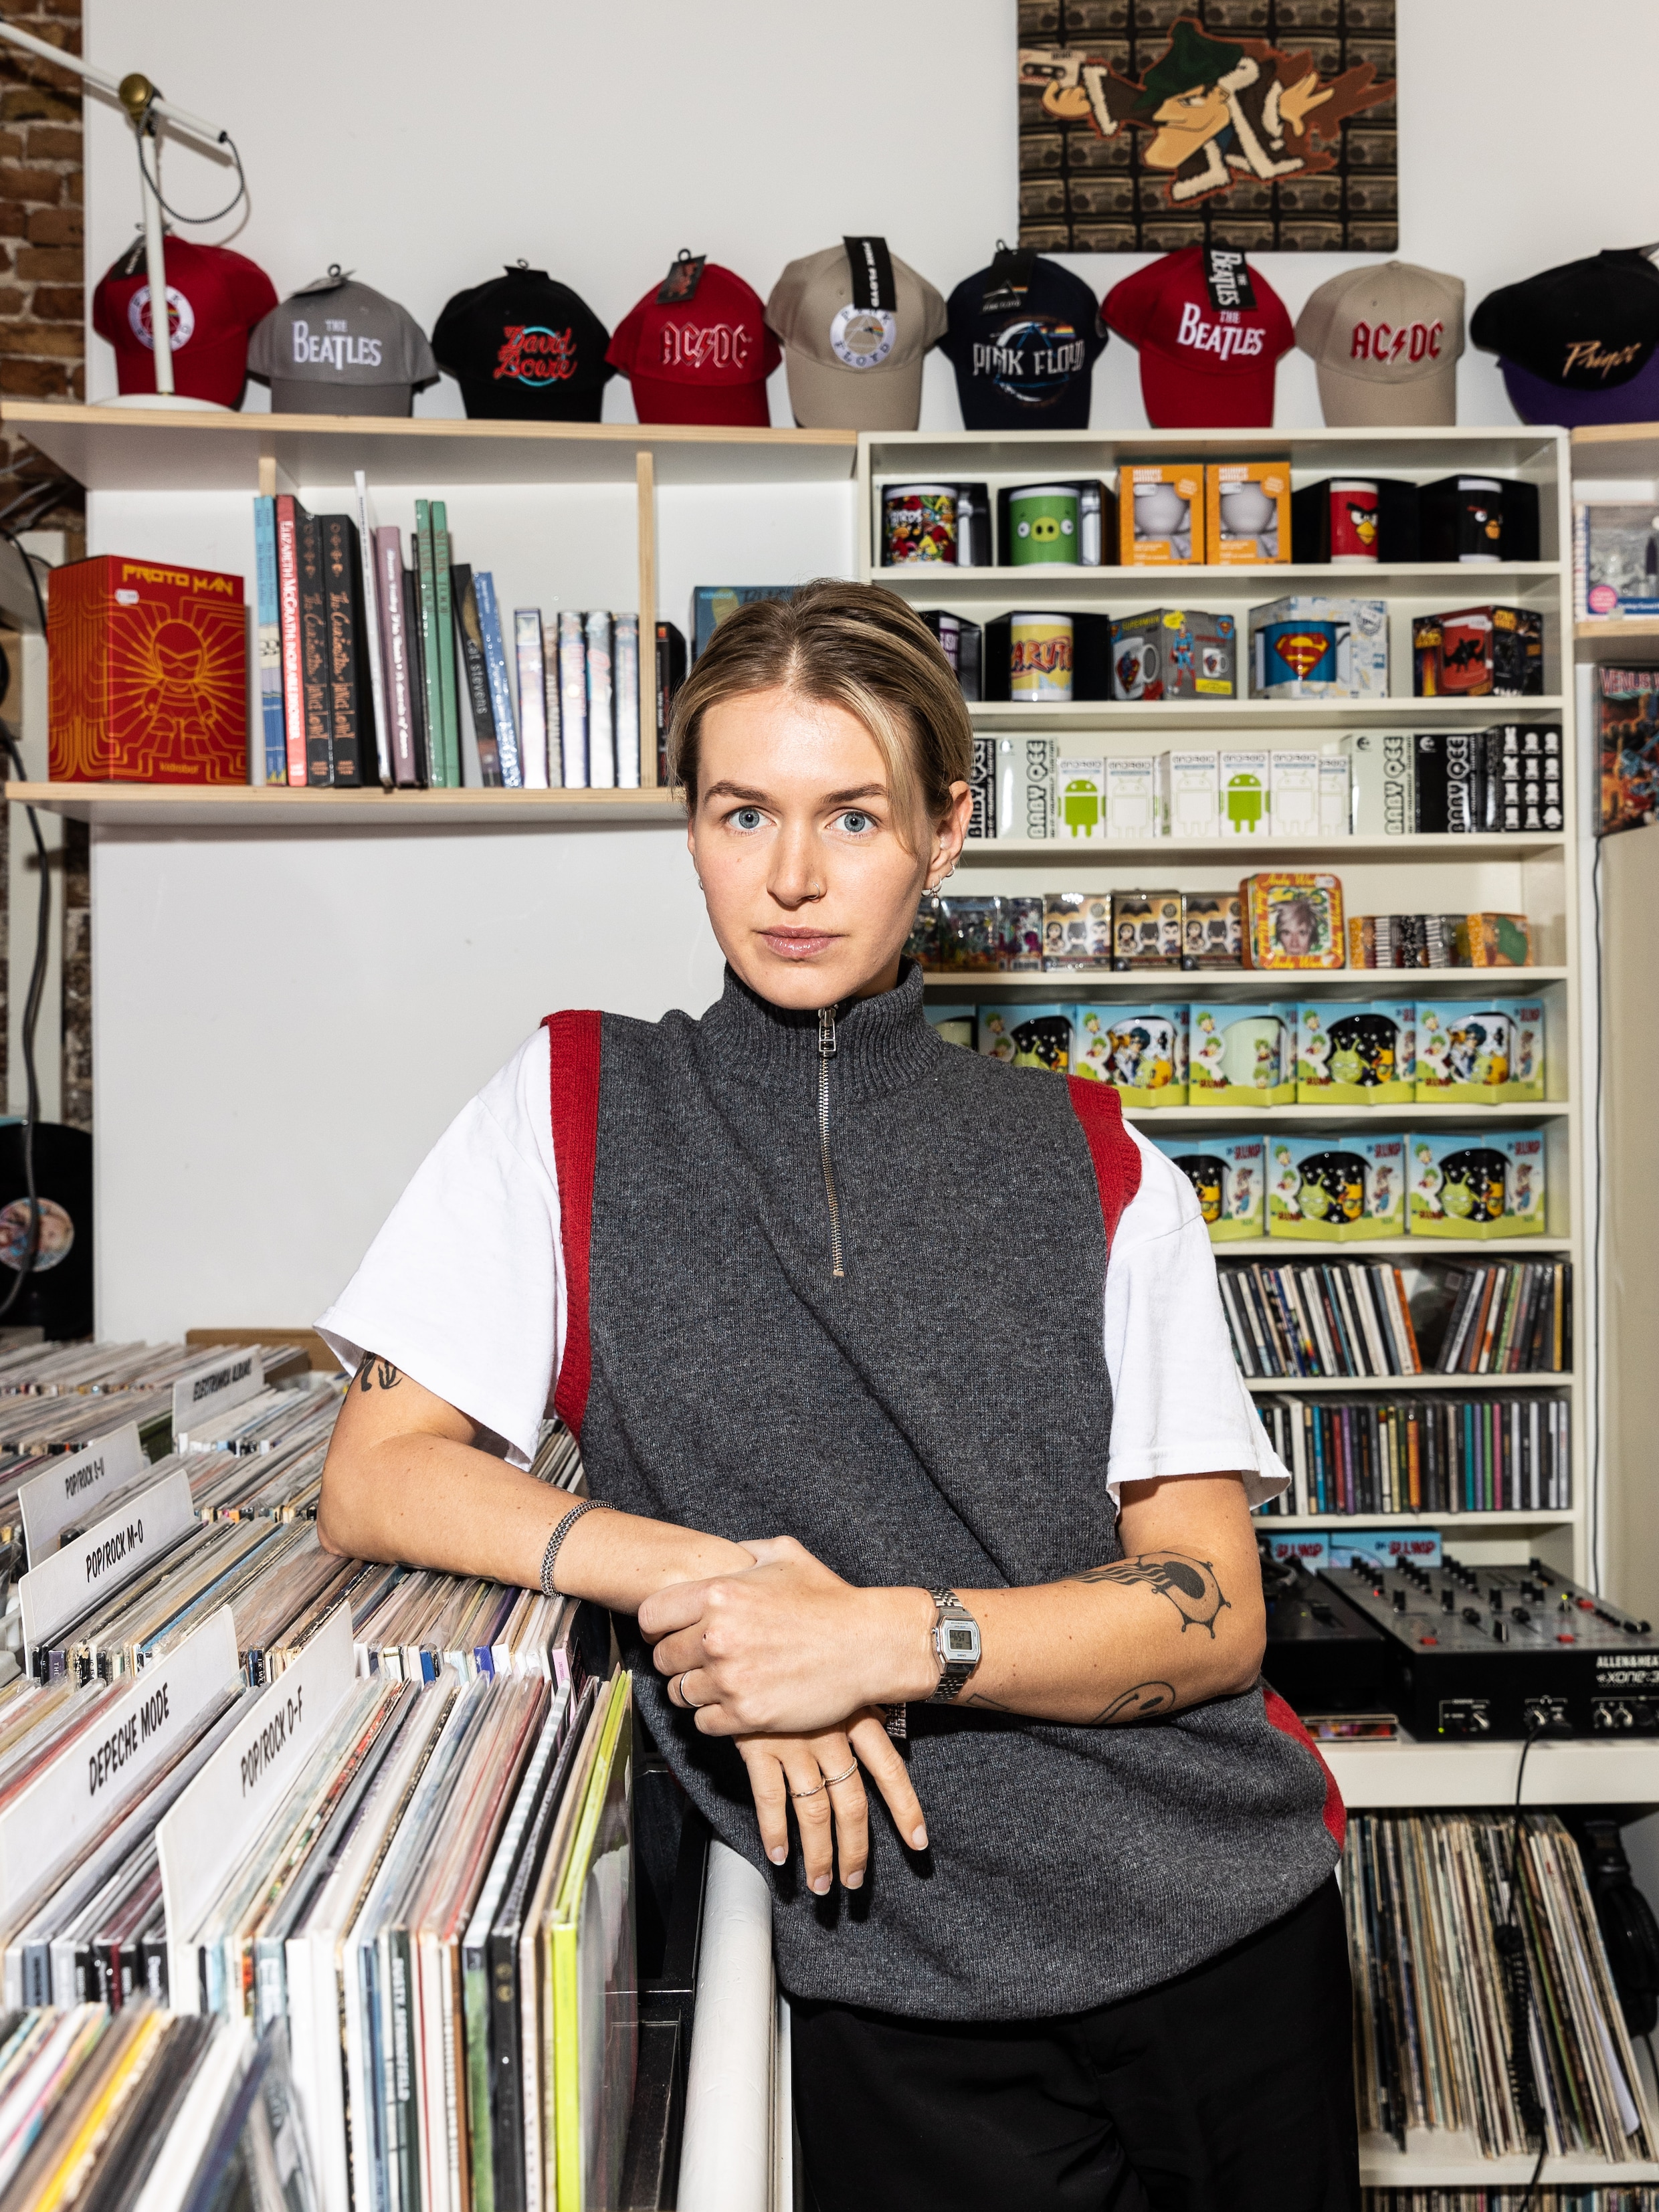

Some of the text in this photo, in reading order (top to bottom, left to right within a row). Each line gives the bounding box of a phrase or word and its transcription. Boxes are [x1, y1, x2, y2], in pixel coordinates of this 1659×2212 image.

[1209, 249, 1243, 306] BEATLES
[325, 319, 348, 332] THE
[502, 324, 578, 356] David
[1176, 302, 1266, 361] BEATLES
[1219, 310, 1241, 324] THE
[292, 320, 382, 371] BEATLES
[494, 351, 579, 380] Bowie
[835, 340, 890, 367] FLOYD
[973, 339, 1085, 376] PINK FLOYD
[280, 520, 295, 578] ELIZABETH
[122, 563, 233, 597] PROTO MAN
[470, 661, 488, 714] stevens
[1026, 740, 1048, 839] BABY QEE
[1383, 736, 1405, 835] BABY QEE
[1447, 779, 1470, 833] BABY
[66, 1464, 94, 1499] POP/ROCK
[85, 1518, 144, 1583] POP/ROCK M-O
[88, 1682, 171, 1797] DEPECHE MODE
[239, 1684, 304, 1799] POP/ROCK D-F
